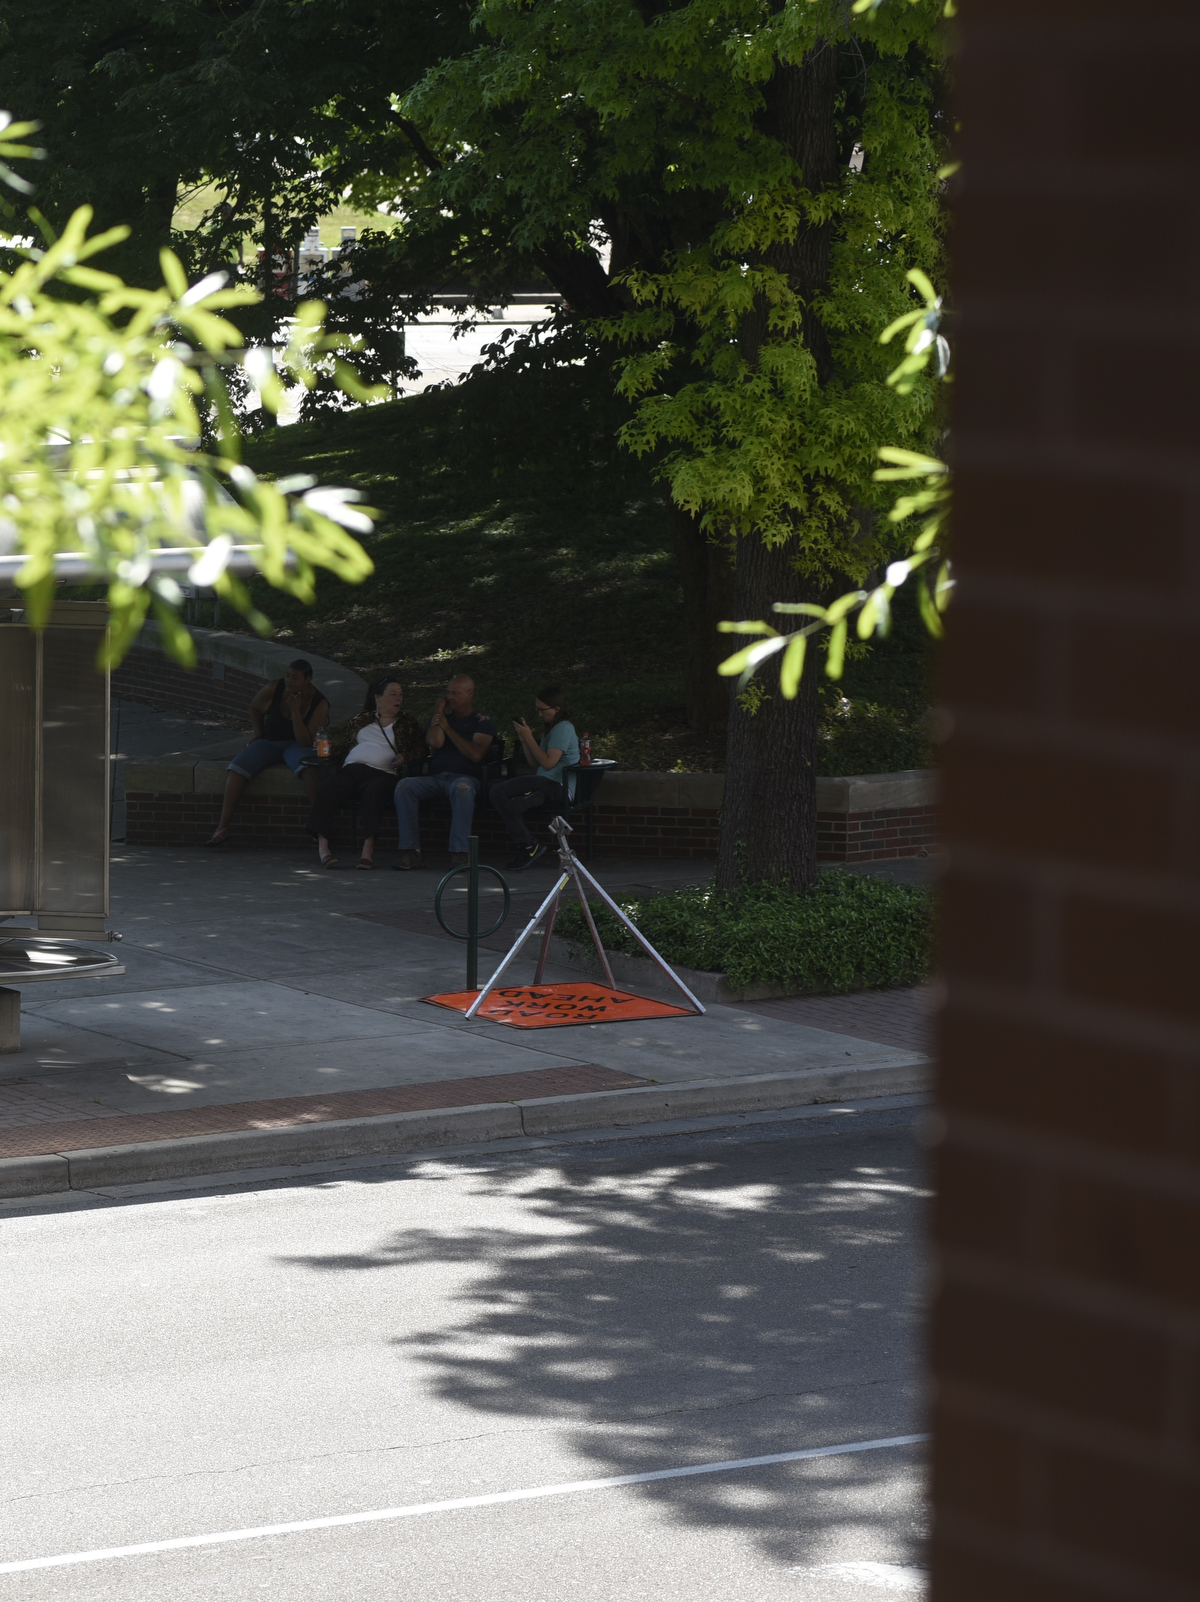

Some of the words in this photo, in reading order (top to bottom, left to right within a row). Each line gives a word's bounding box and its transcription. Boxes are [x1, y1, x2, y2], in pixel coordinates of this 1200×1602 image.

[498, 990, 636, 1004] AHEAD
[505, 1000, 607, 1012] WORK
[488, 1009, 598, 1020] ROAD
